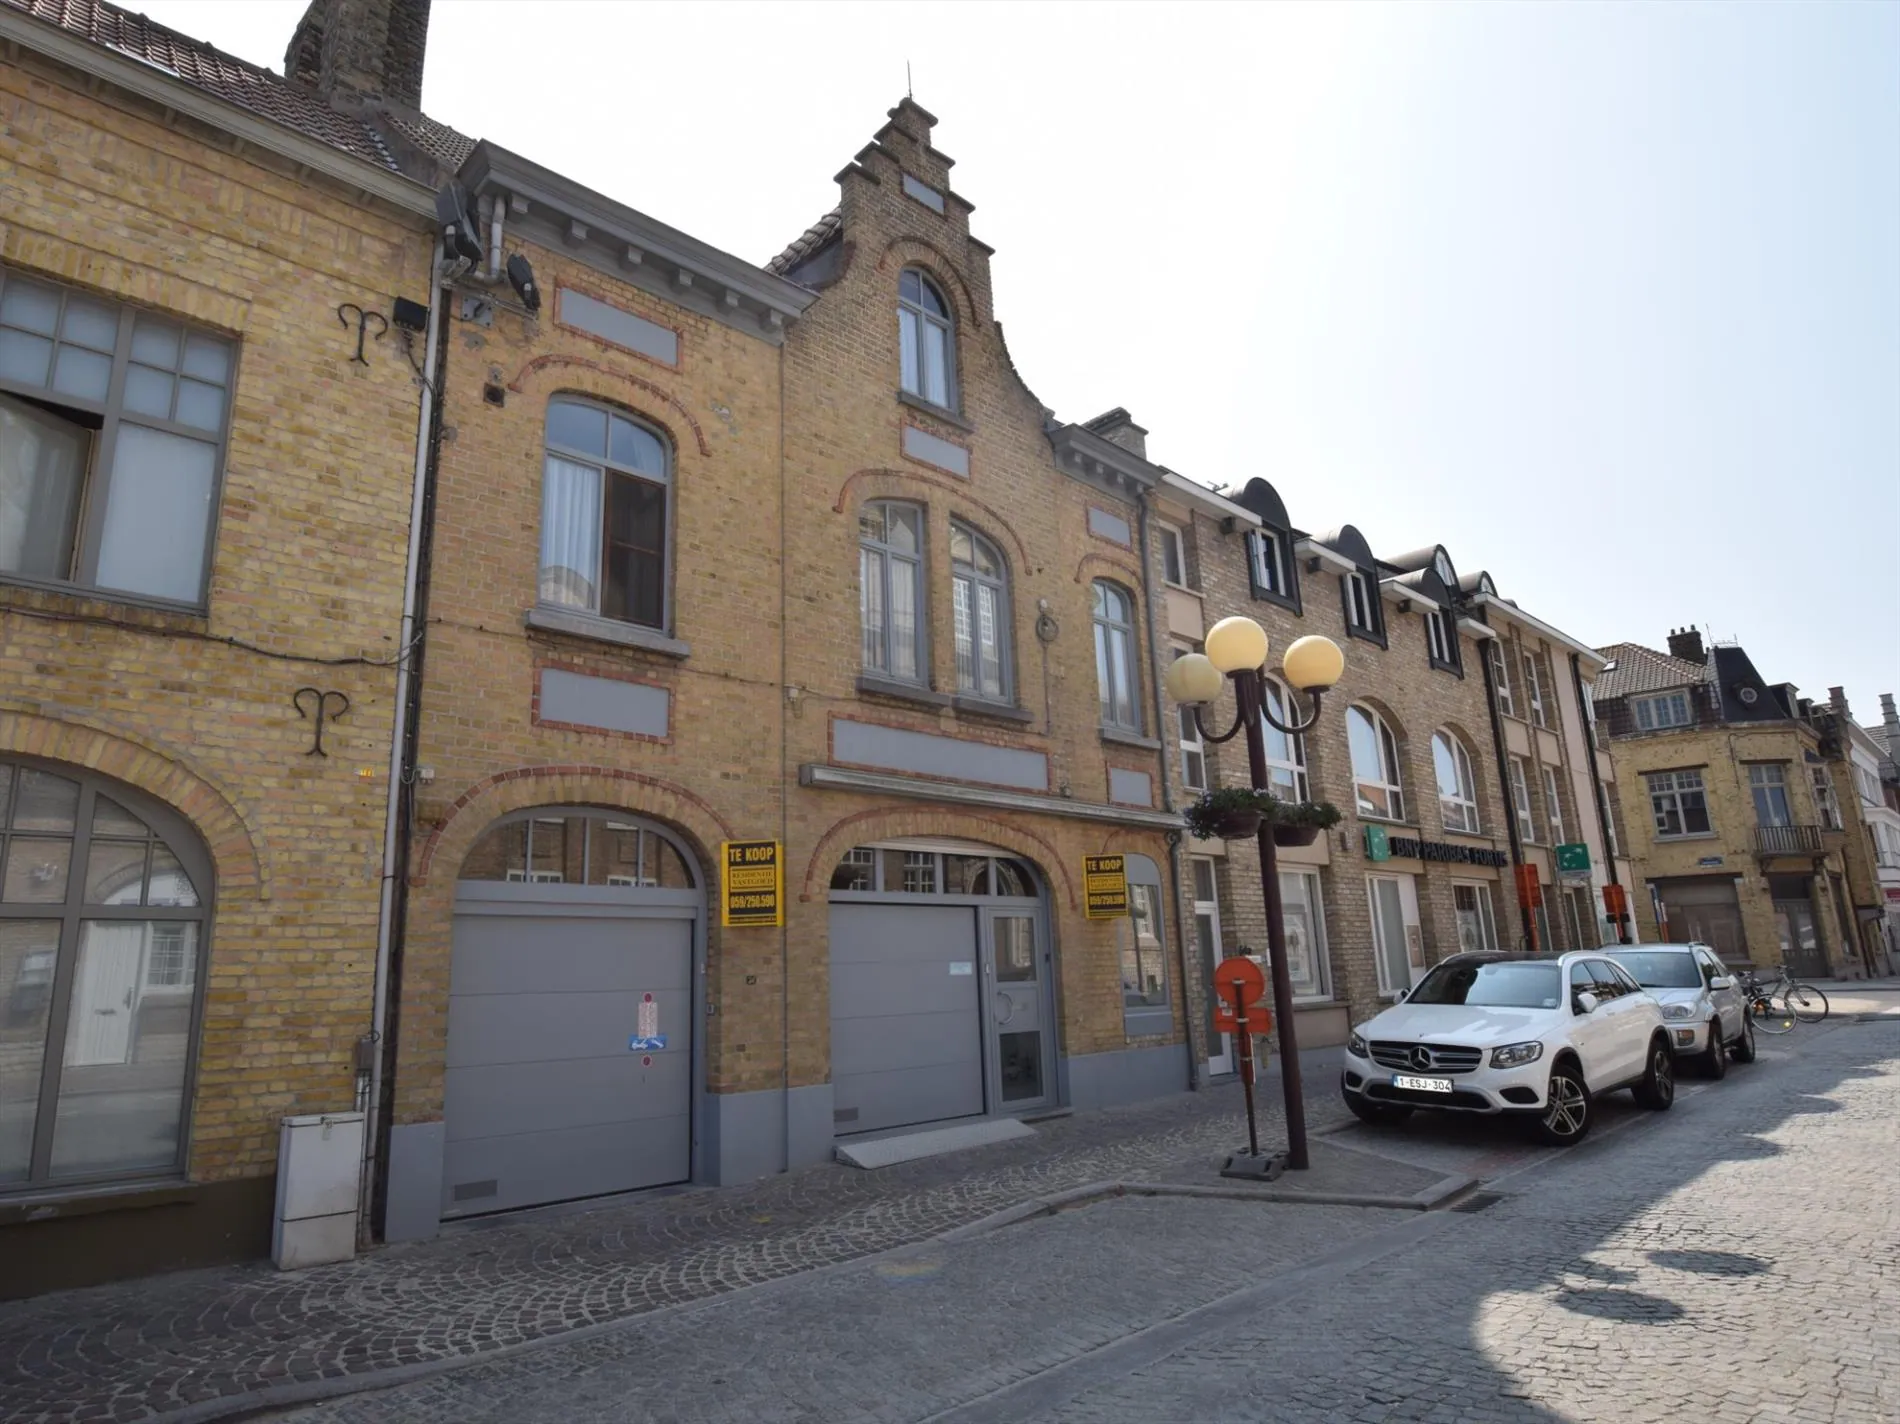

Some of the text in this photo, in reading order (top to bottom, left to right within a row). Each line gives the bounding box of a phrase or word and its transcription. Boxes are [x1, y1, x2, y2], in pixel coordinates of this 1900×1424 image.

[729, 846, 774, 862] TE KOOP
[1422, 842, 1470, 864] PARIBAS
[1473, 847, 1508, 867] FORTIS
[1087, 859, 1122, 871] TE KOOP
[1400, 1078, 1451, 1091] 1-ESJ-304
